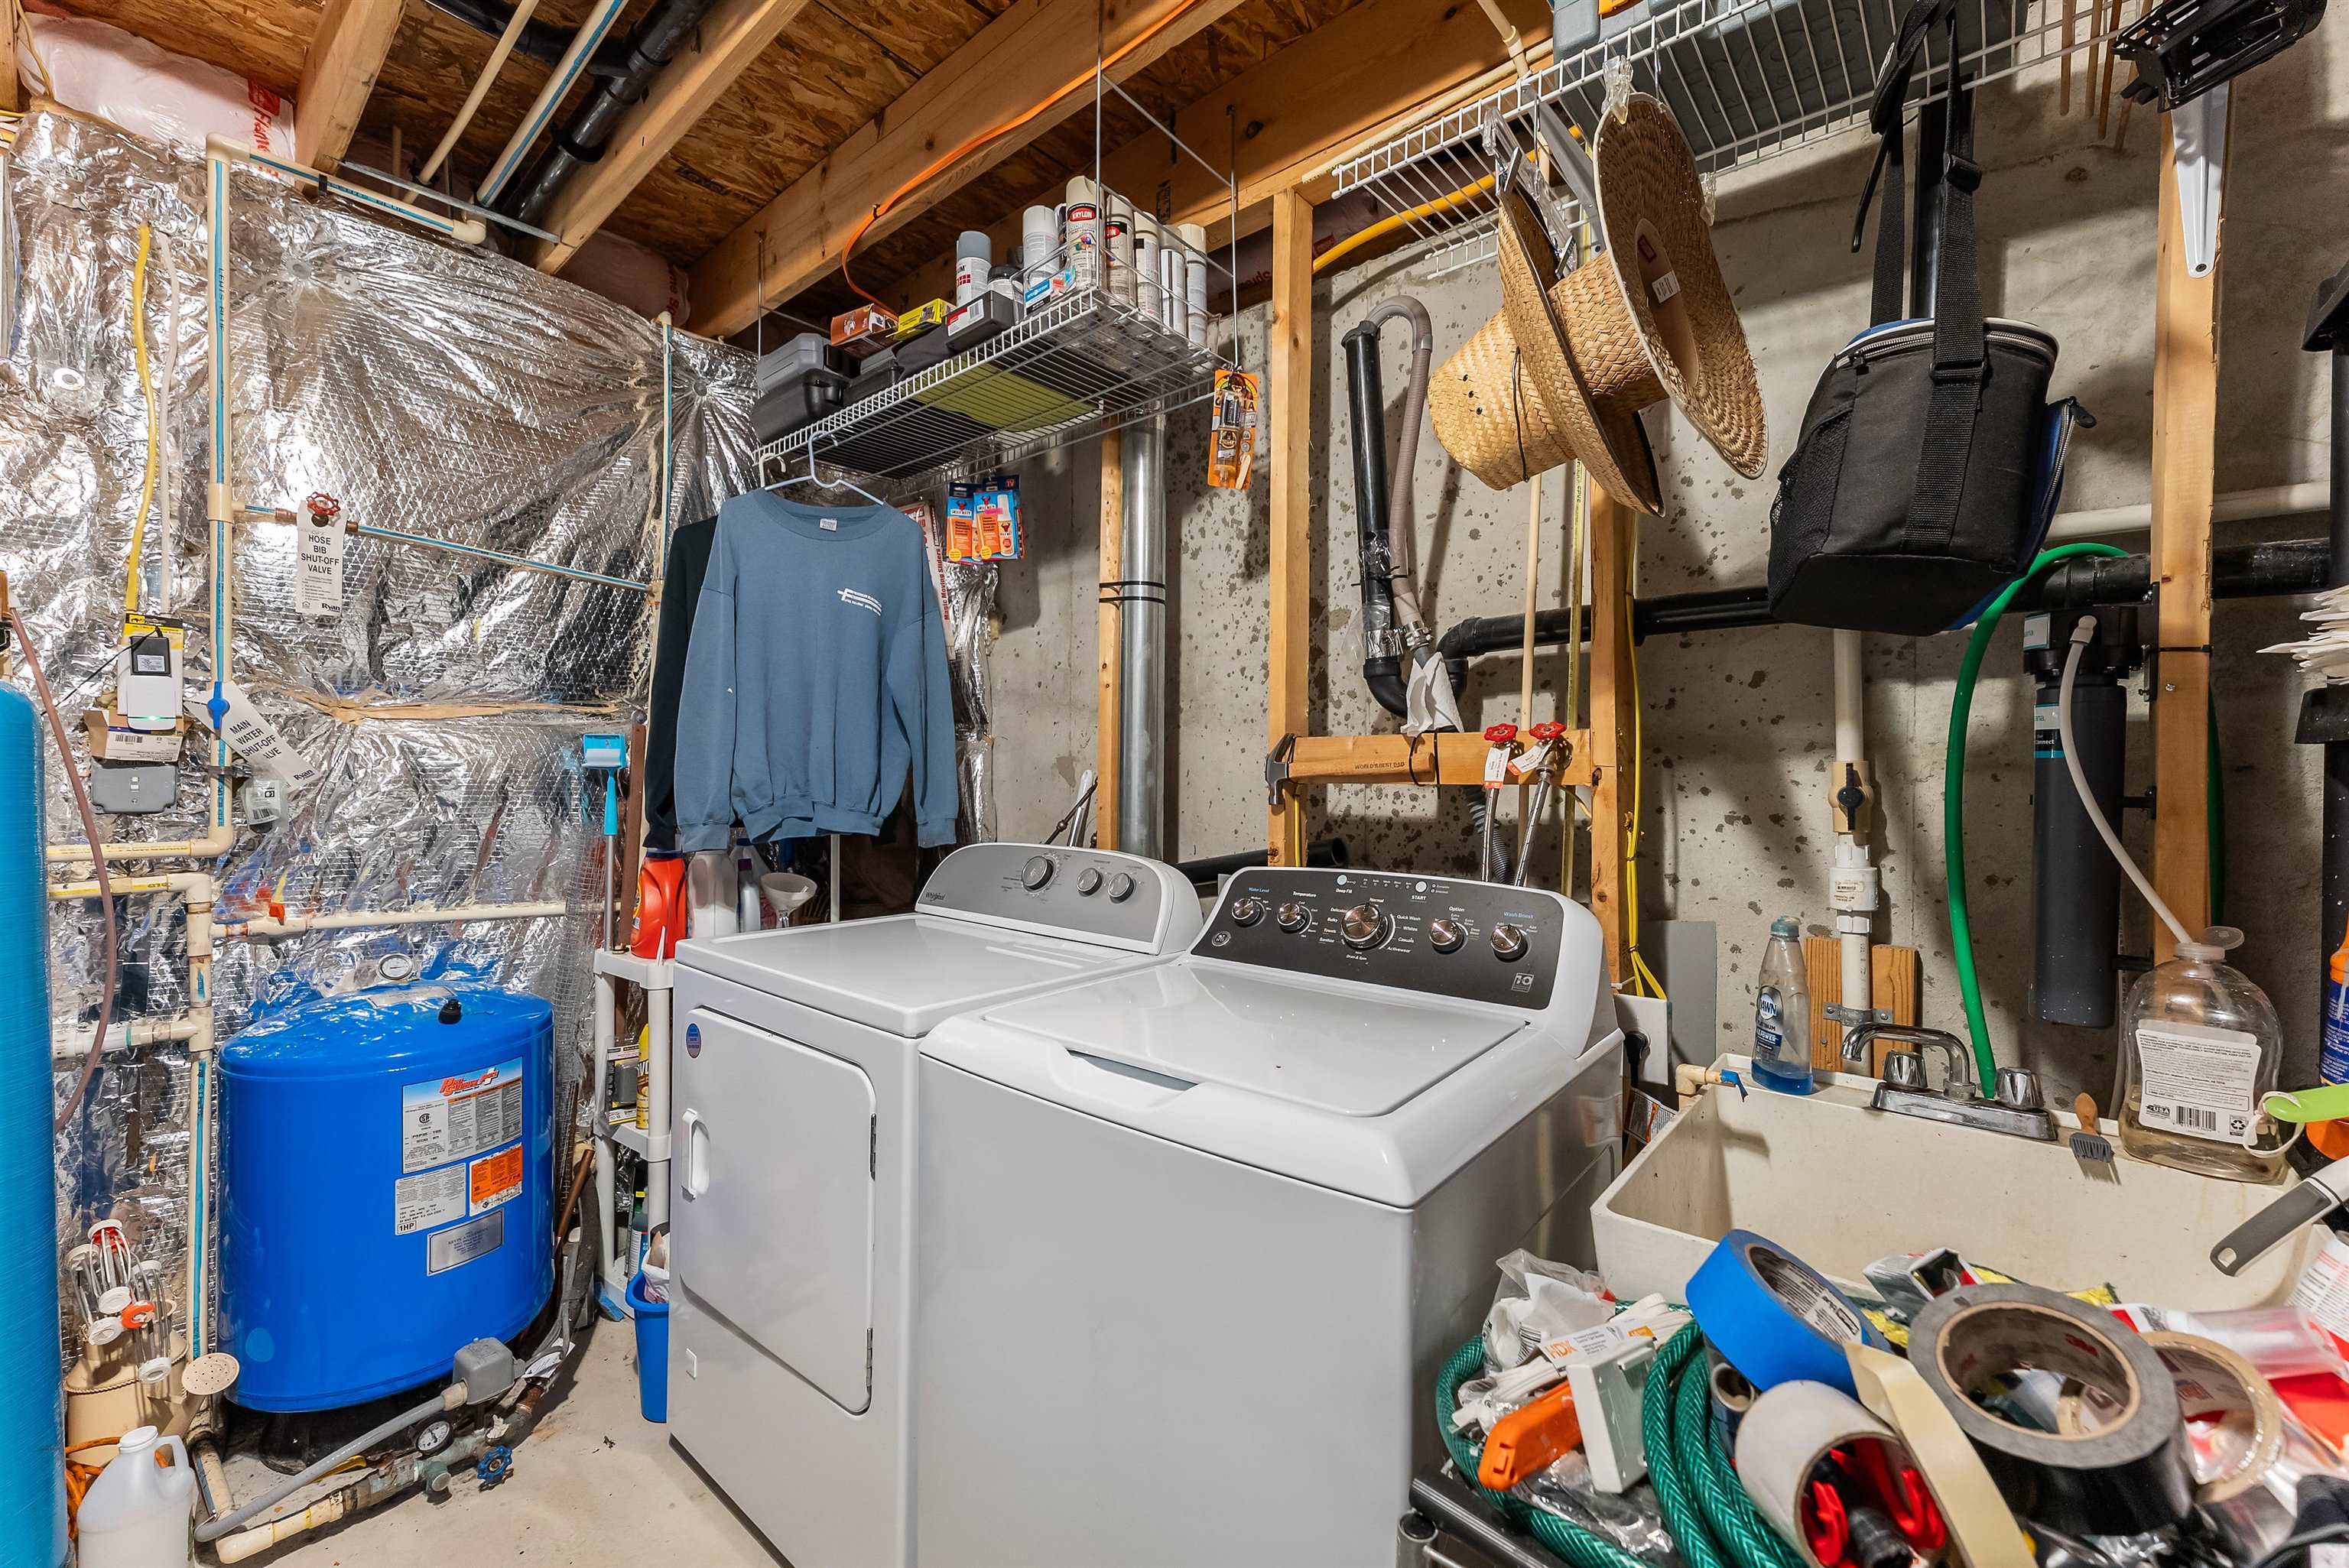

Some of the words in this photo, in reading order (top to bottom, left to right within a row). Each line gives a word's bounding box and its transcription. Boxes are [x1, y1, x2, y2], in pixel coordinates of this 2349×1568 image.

[1072, 210, 1093, 220] KRYLON
[308, 535, 331, 545] HOSE
[314, 545, 327, 554] BIB
[301, 553, 340, 566] SHUT-OFF
[307, 563, 332, 574] VALVE
[321, 602, 340, 611] Ryan
[229, 719, 252, 735] MAIN
[236, 728, 265, 745] WATER
[241, 735, 276, 757] SHUT-OFF
[263, 747, 281, 759] LVE
[293, 769, 314, 781] Ryan
[1516, 975, 1532, 985] 10
[2153, 1105, 2171, 1115] USA
[399, 1222, 414, 1232] 1HP
[1545, 1340, 1578, 1359] HDX
